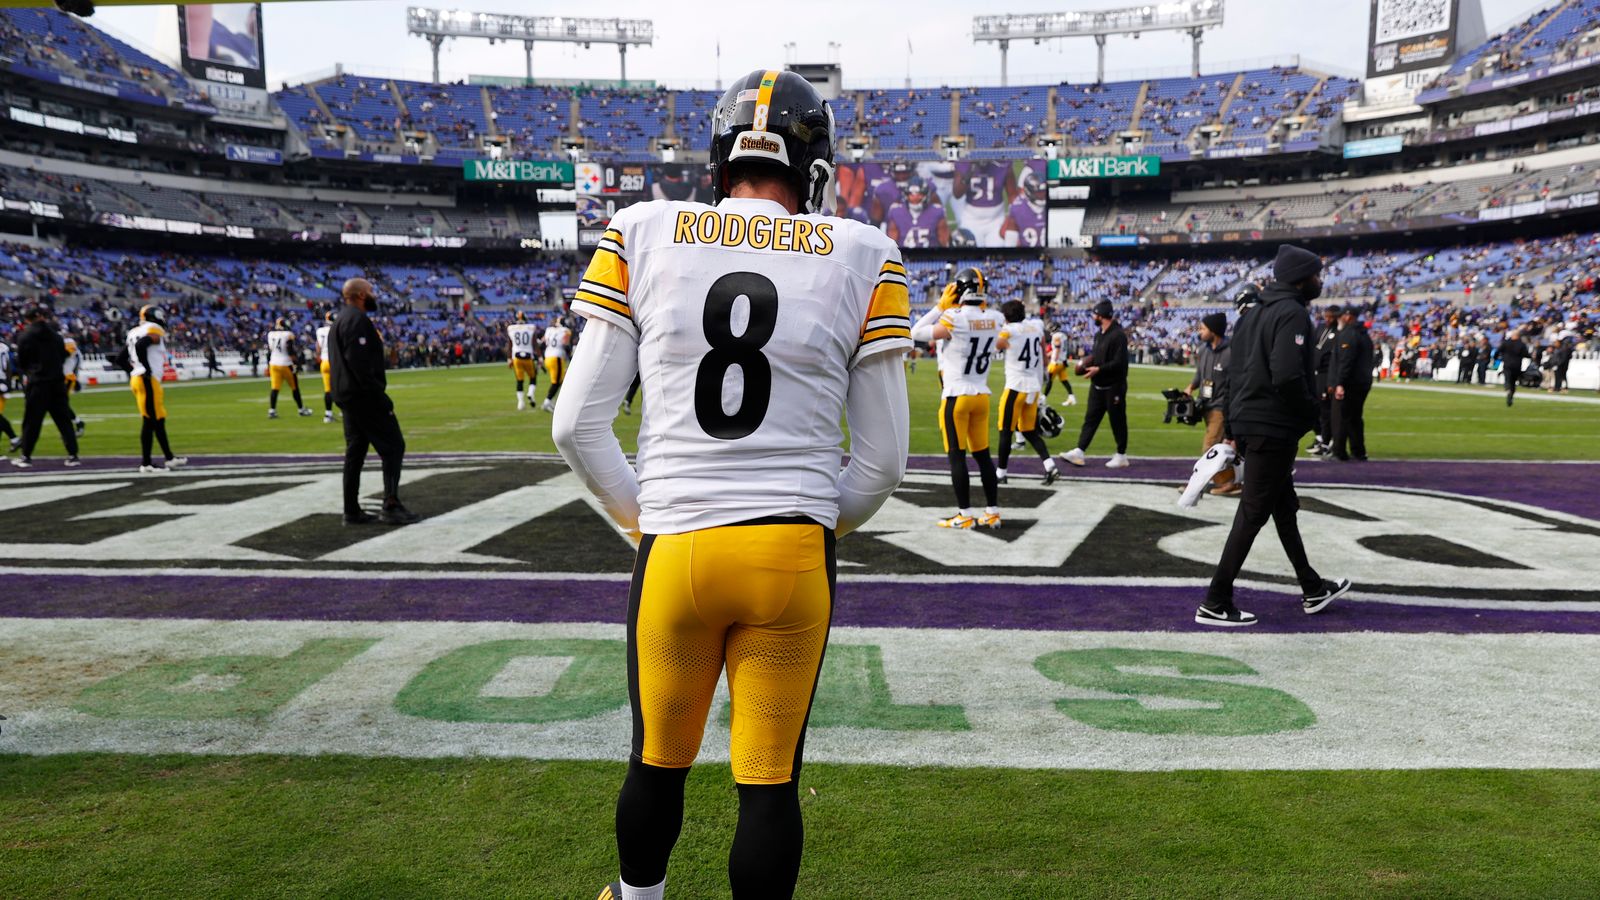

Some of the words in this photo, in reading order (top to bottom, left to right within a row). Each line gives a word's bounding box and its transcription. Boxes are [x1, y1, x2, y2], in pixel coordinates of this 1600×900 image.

[754, 104, 768, 130] 8
[740, 135, 781, 154] Steelers
[606, 168, 614, 187] 0
[970, 177, 994, 201] 51
[673, 210, 834, 256] RODGERS
[903, 229, 930, 247] 45
[515, 332, 530, 346] 80
[694, 271, 778, 440] 8
[964, 337, 994, 375] 16
[1018, 337, 1041, 369] 49
[76, 637, 1317, 736] STOP
